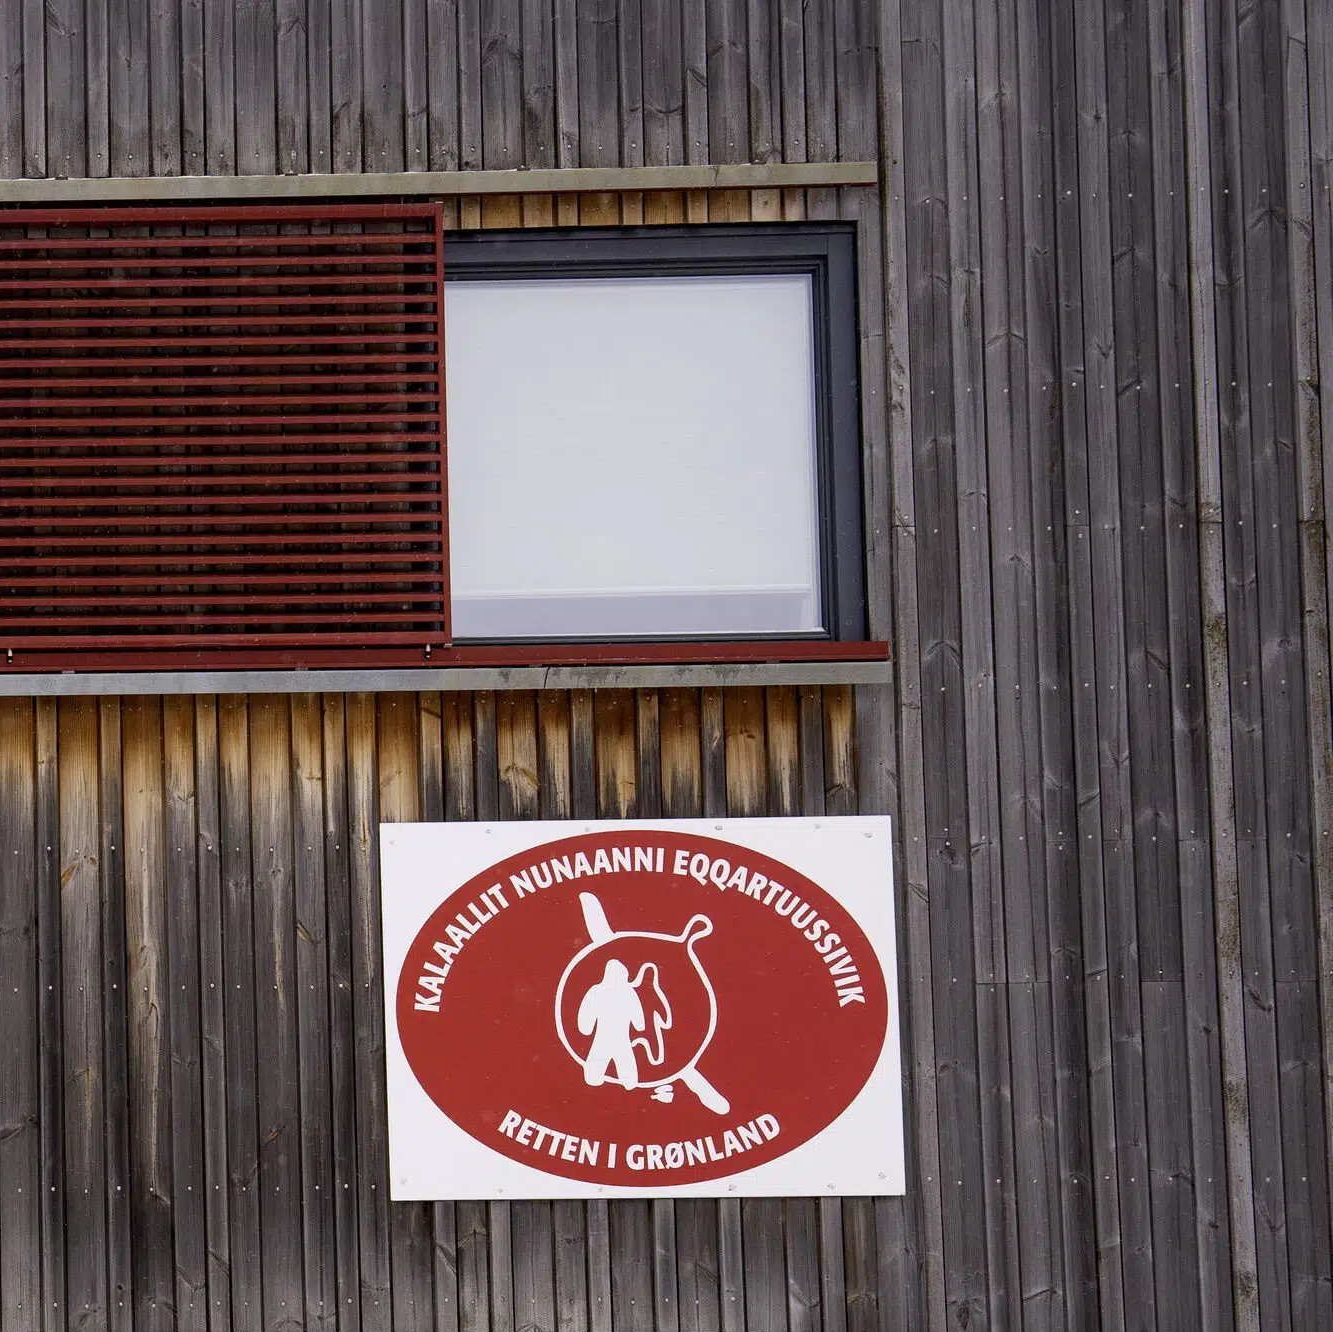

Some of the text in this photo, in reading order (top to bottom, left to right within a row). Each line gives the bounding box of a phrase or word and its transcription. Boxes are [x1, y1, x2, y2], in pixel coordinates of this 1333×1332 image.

[413, 846, 866, 1013] KALAALLIT NUNAANNI EQQARTUUSSIVIK
[497, 1109, 781, 1171] RETTEN I GRØNLAND
